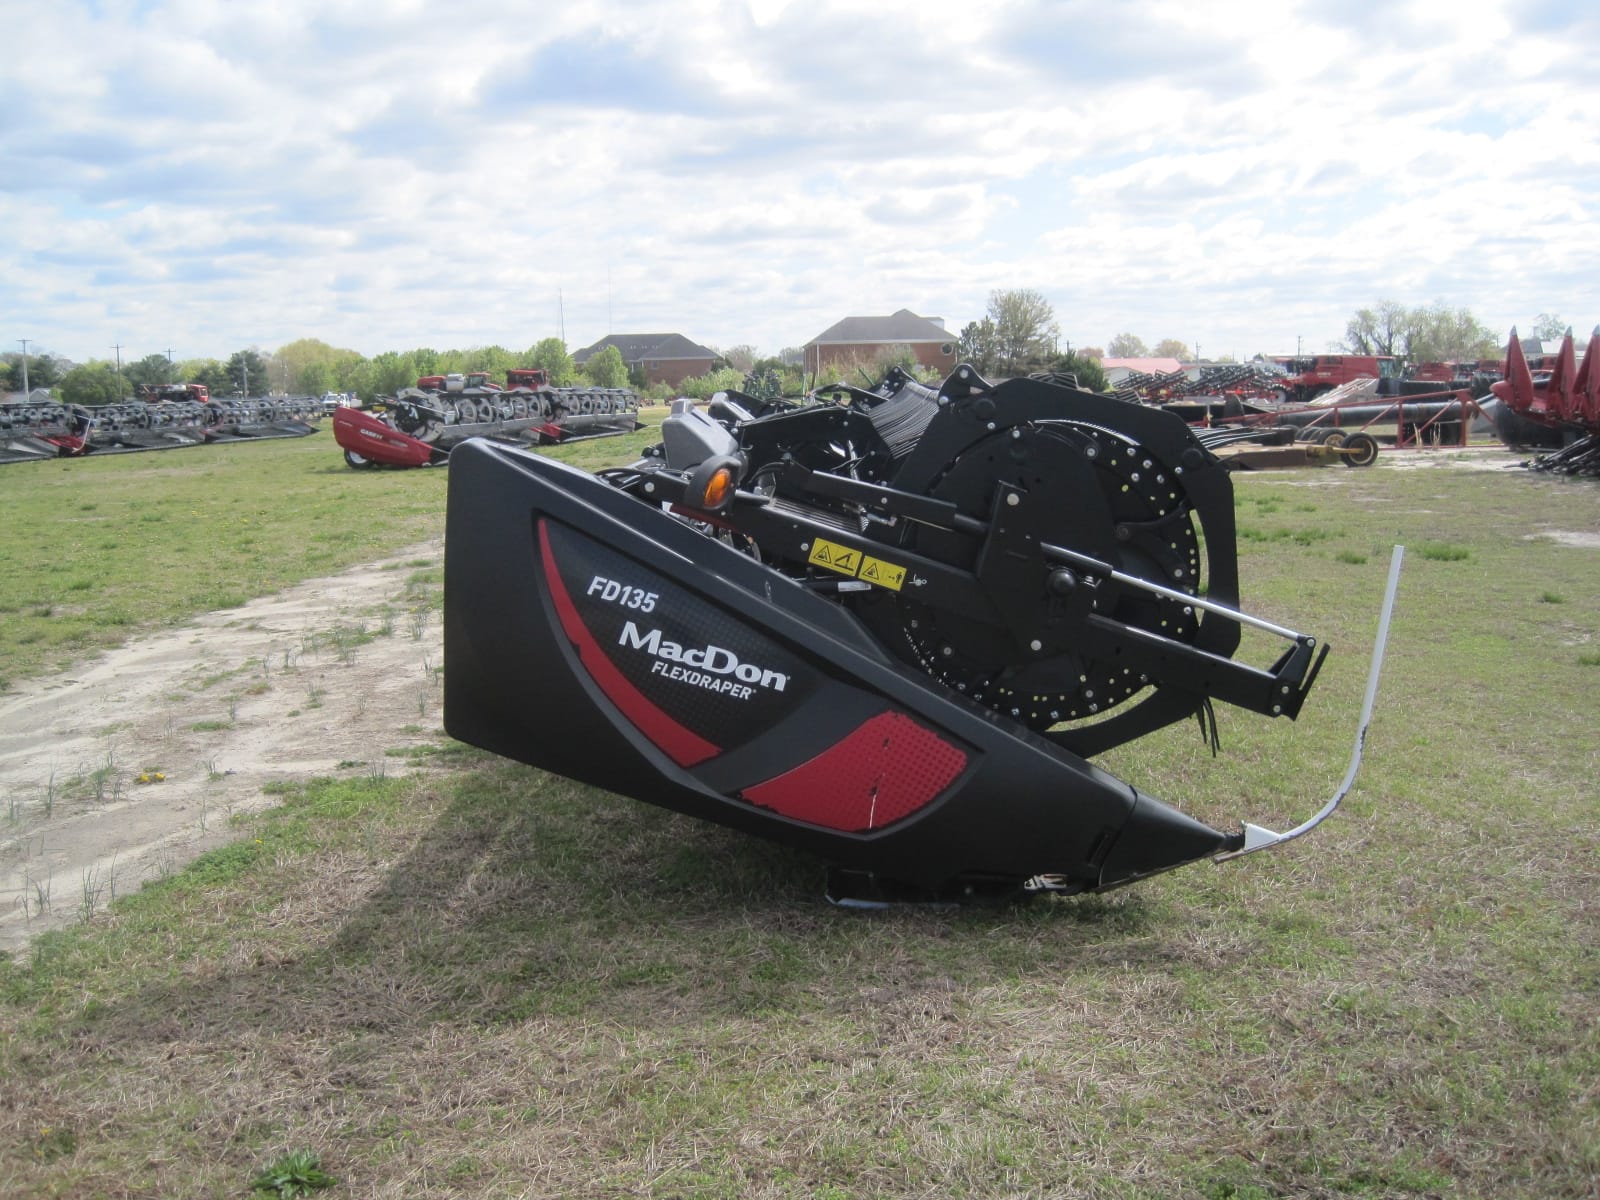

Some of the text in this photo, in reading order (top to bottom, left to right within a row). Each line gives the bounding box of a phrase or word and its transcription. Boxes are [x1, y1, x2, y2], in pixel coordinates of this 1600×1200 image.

[587, 575, 659, 613] FD135
[618, 621, 788, 692] MacDon
[651, 661, 753, 700] FLEXDRAPER
